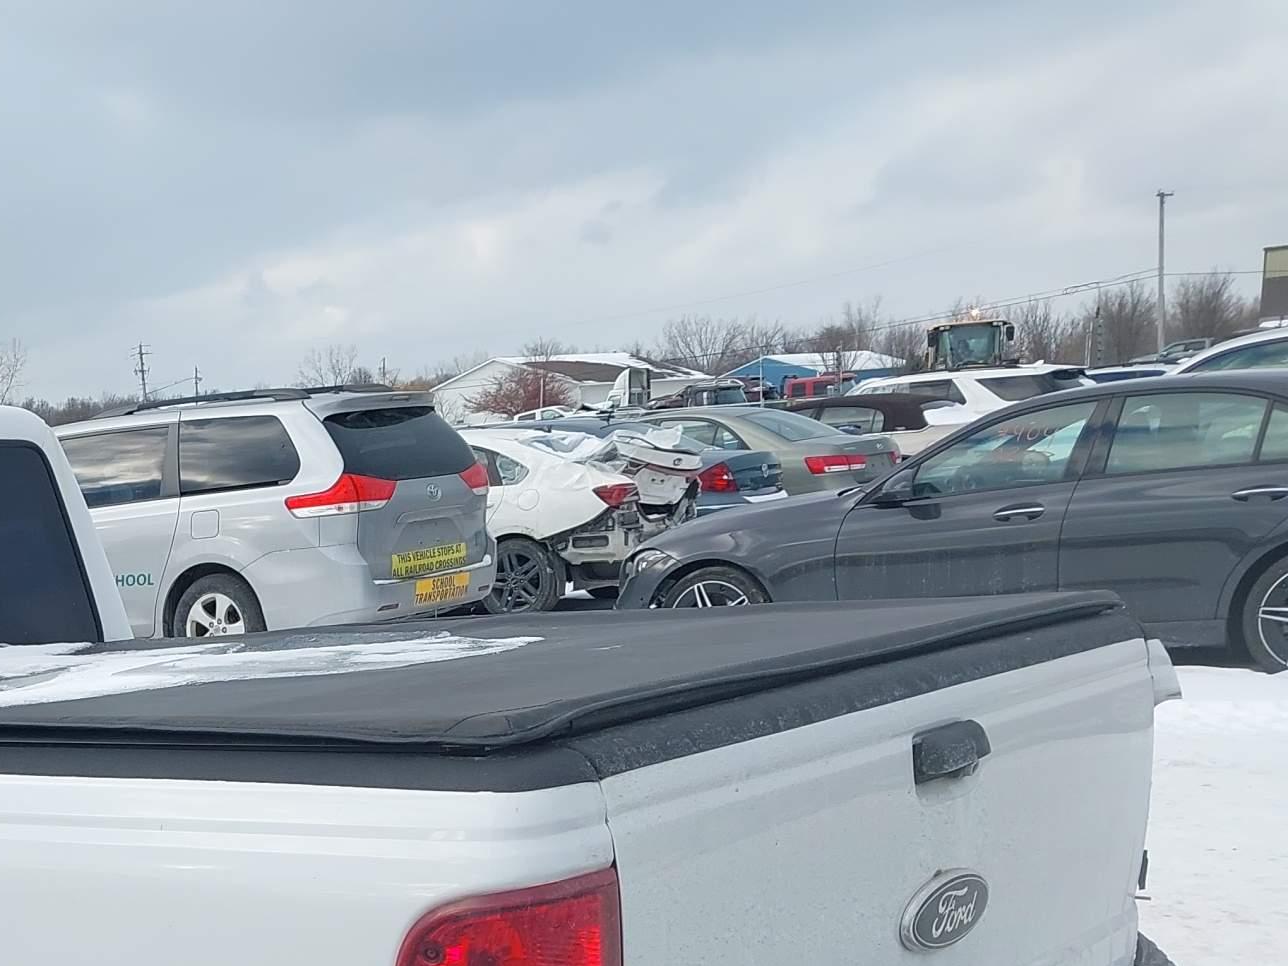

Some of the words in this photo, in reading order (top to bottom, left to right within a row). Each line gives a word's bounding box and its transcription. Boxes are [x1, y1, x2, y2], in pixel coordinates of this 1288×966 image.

[397, 554, 411, 564] THIS
[412, 551, 435, 562] VEHICLE
[436, 546, 455, 557] STOPS
[455, 543, 462, 556] AT
[393, 568, 403, 577] ALL
[404, 563, 434, 575] RAILROAD
[435, 557, 465, 570] CROSSINGS
[432, 576, 455, 590] SCHOOL
[415, 586, 468, 604] TRANSPORTATION
[932, 886, 978, 939] Ford
